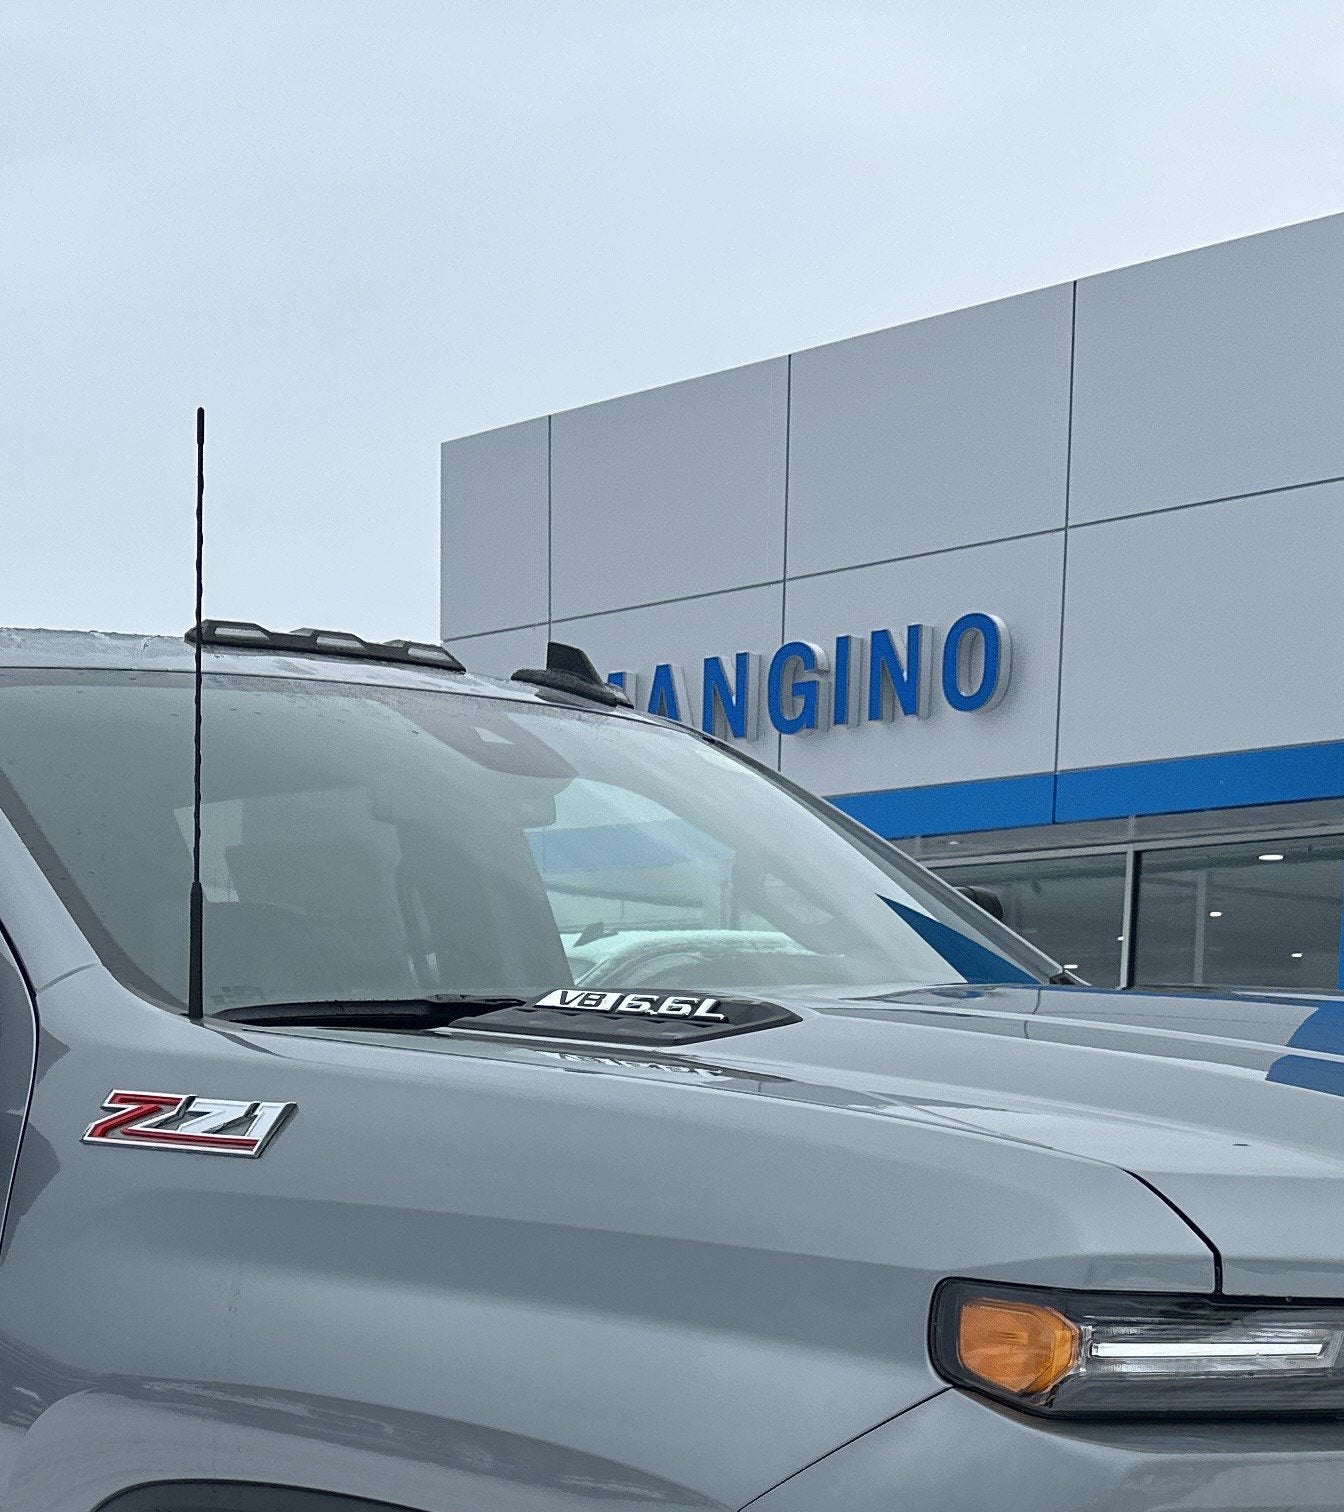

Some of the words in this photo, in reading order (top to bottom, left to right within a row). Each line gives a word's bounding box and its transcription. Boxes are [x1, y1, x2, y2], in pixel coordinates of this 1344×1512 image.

[607, 612, 1008, 739] ANGINO
[615, 993, 730, 1022] 6.6L
[79, 1088, 297, 1158] Z71
